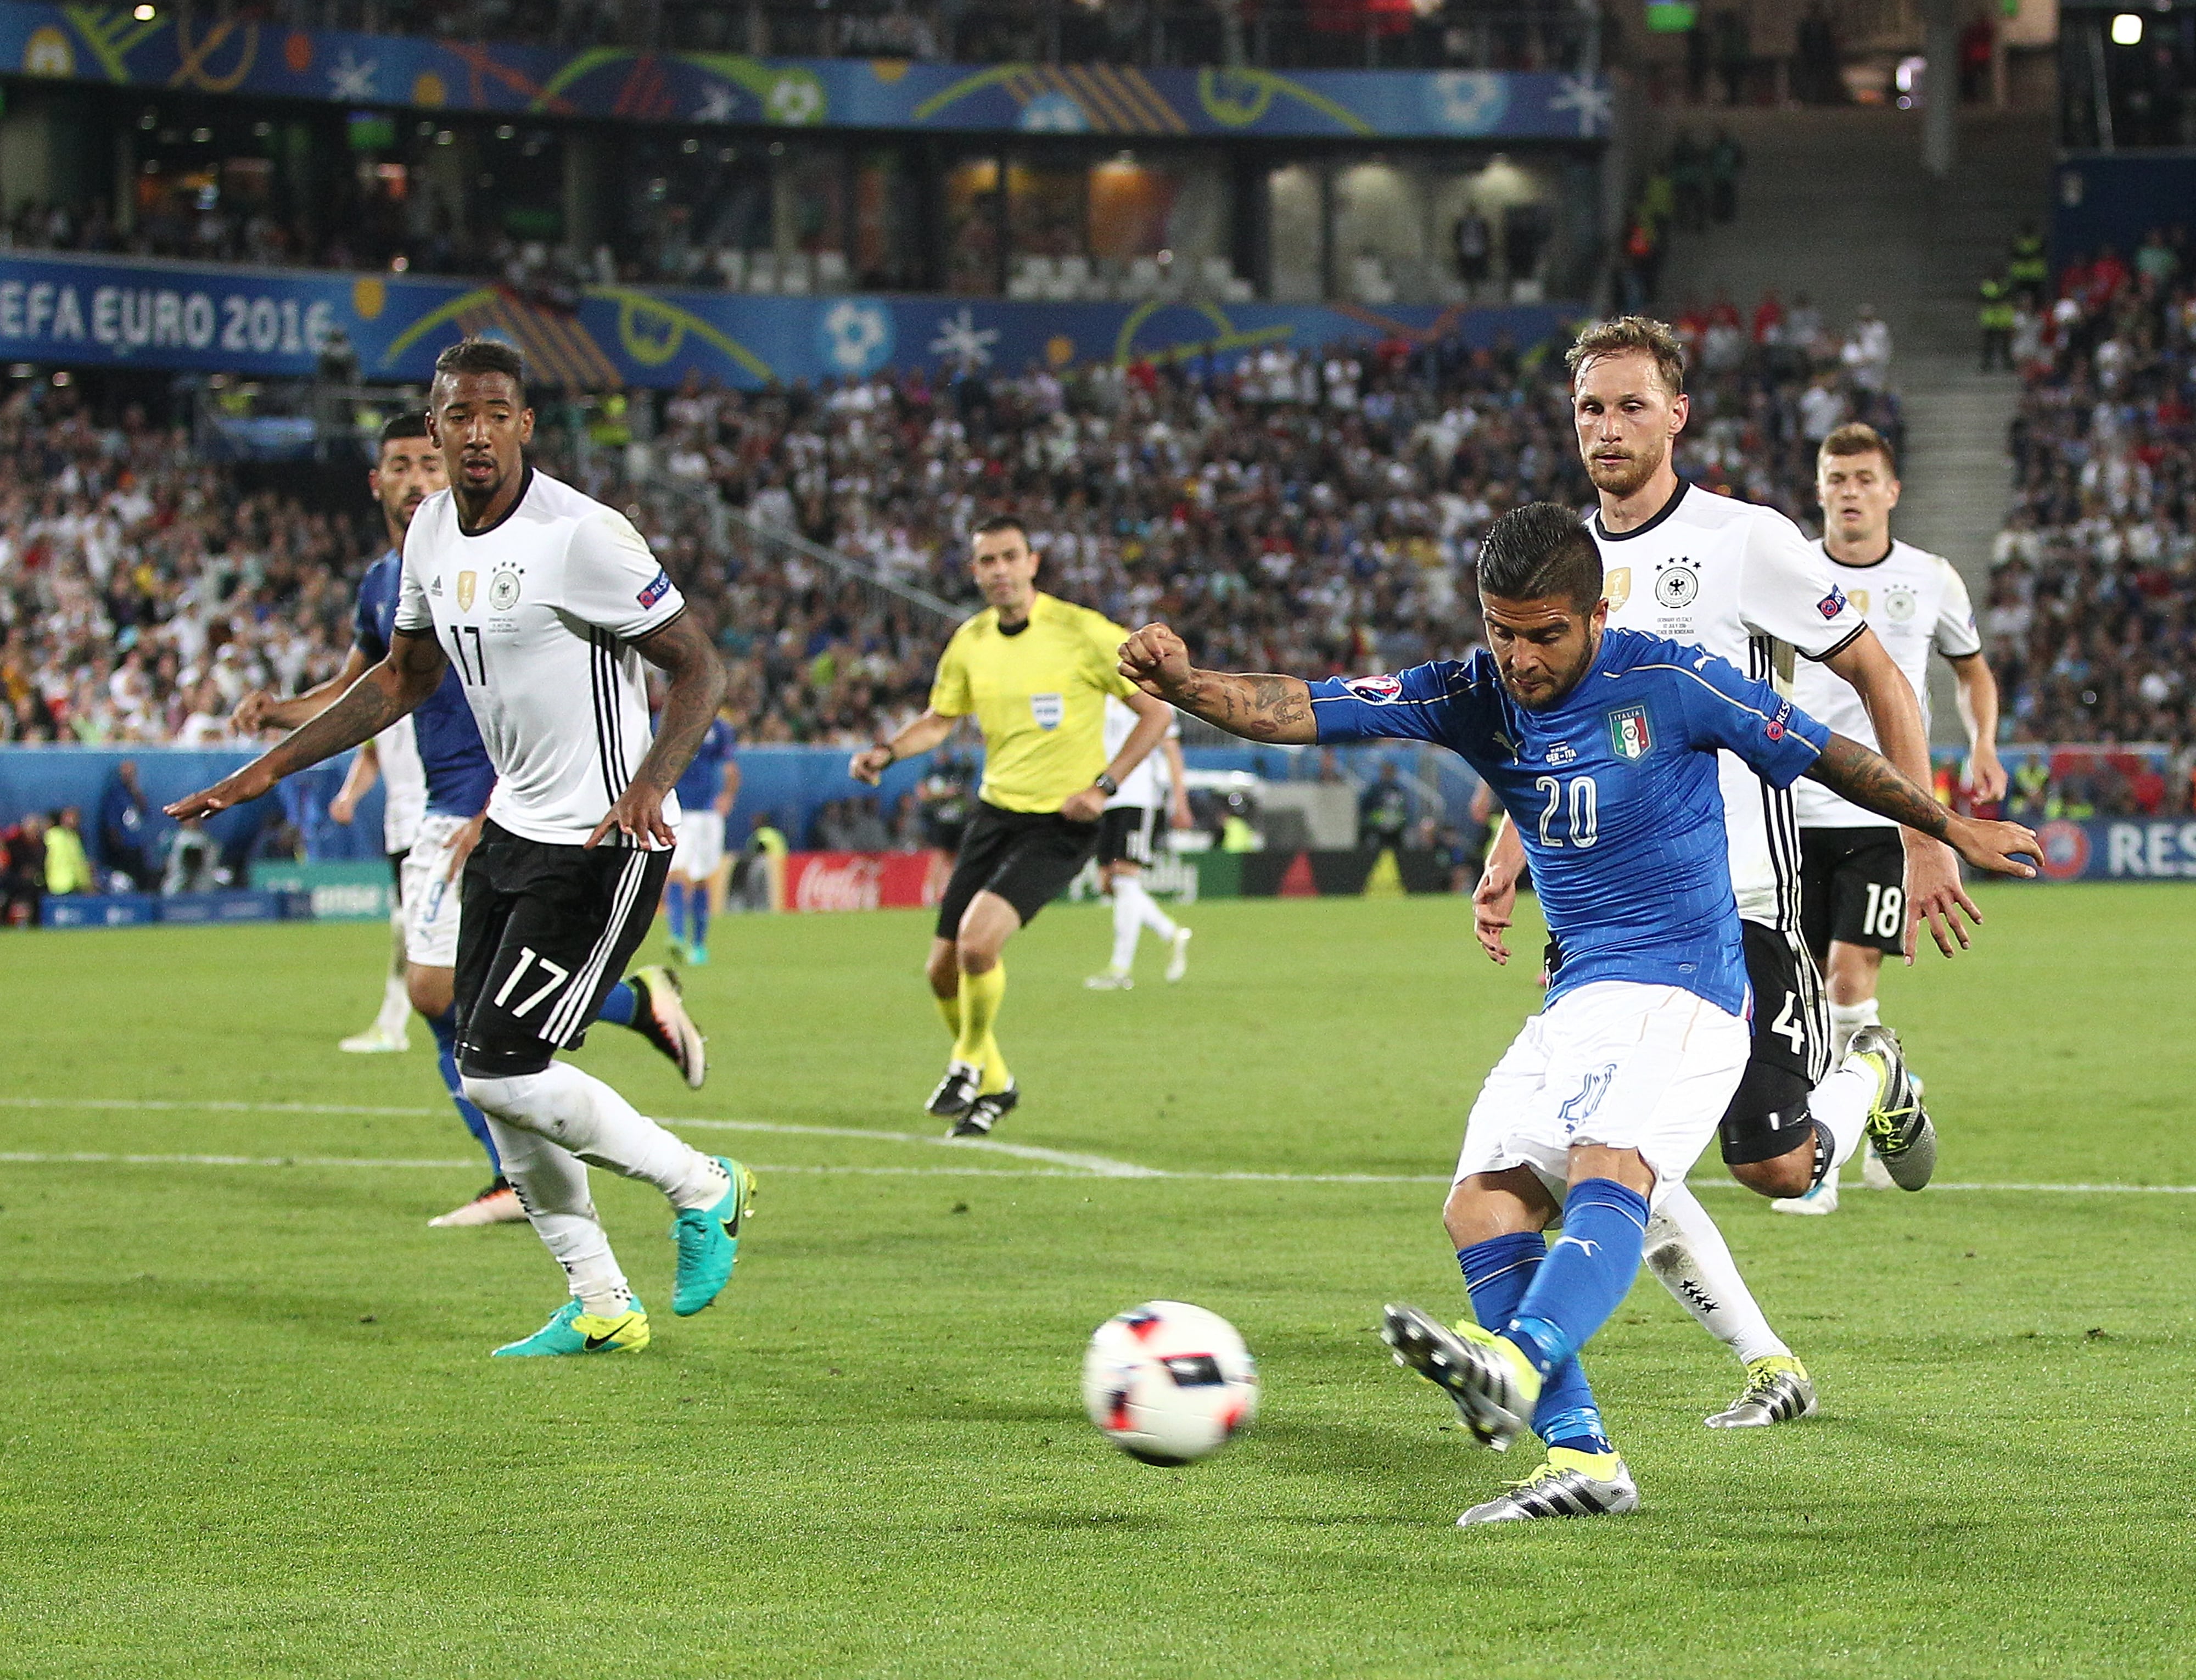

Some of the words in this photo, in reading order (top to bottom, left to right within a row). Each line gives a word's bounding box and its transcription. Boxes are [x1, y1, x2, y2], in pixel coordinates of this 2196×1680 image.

[91, 285, 215, 350] EURO
[450, 625, 486, 686] 17
[1614, 710, 1640, 720] ITALIA
[1536, 776, 1598, 848] 20
[1863, 883, 1902, 938] 18
[494, 945, 569, 1018] 17
[1772, 990, 1805, 1055] 4
